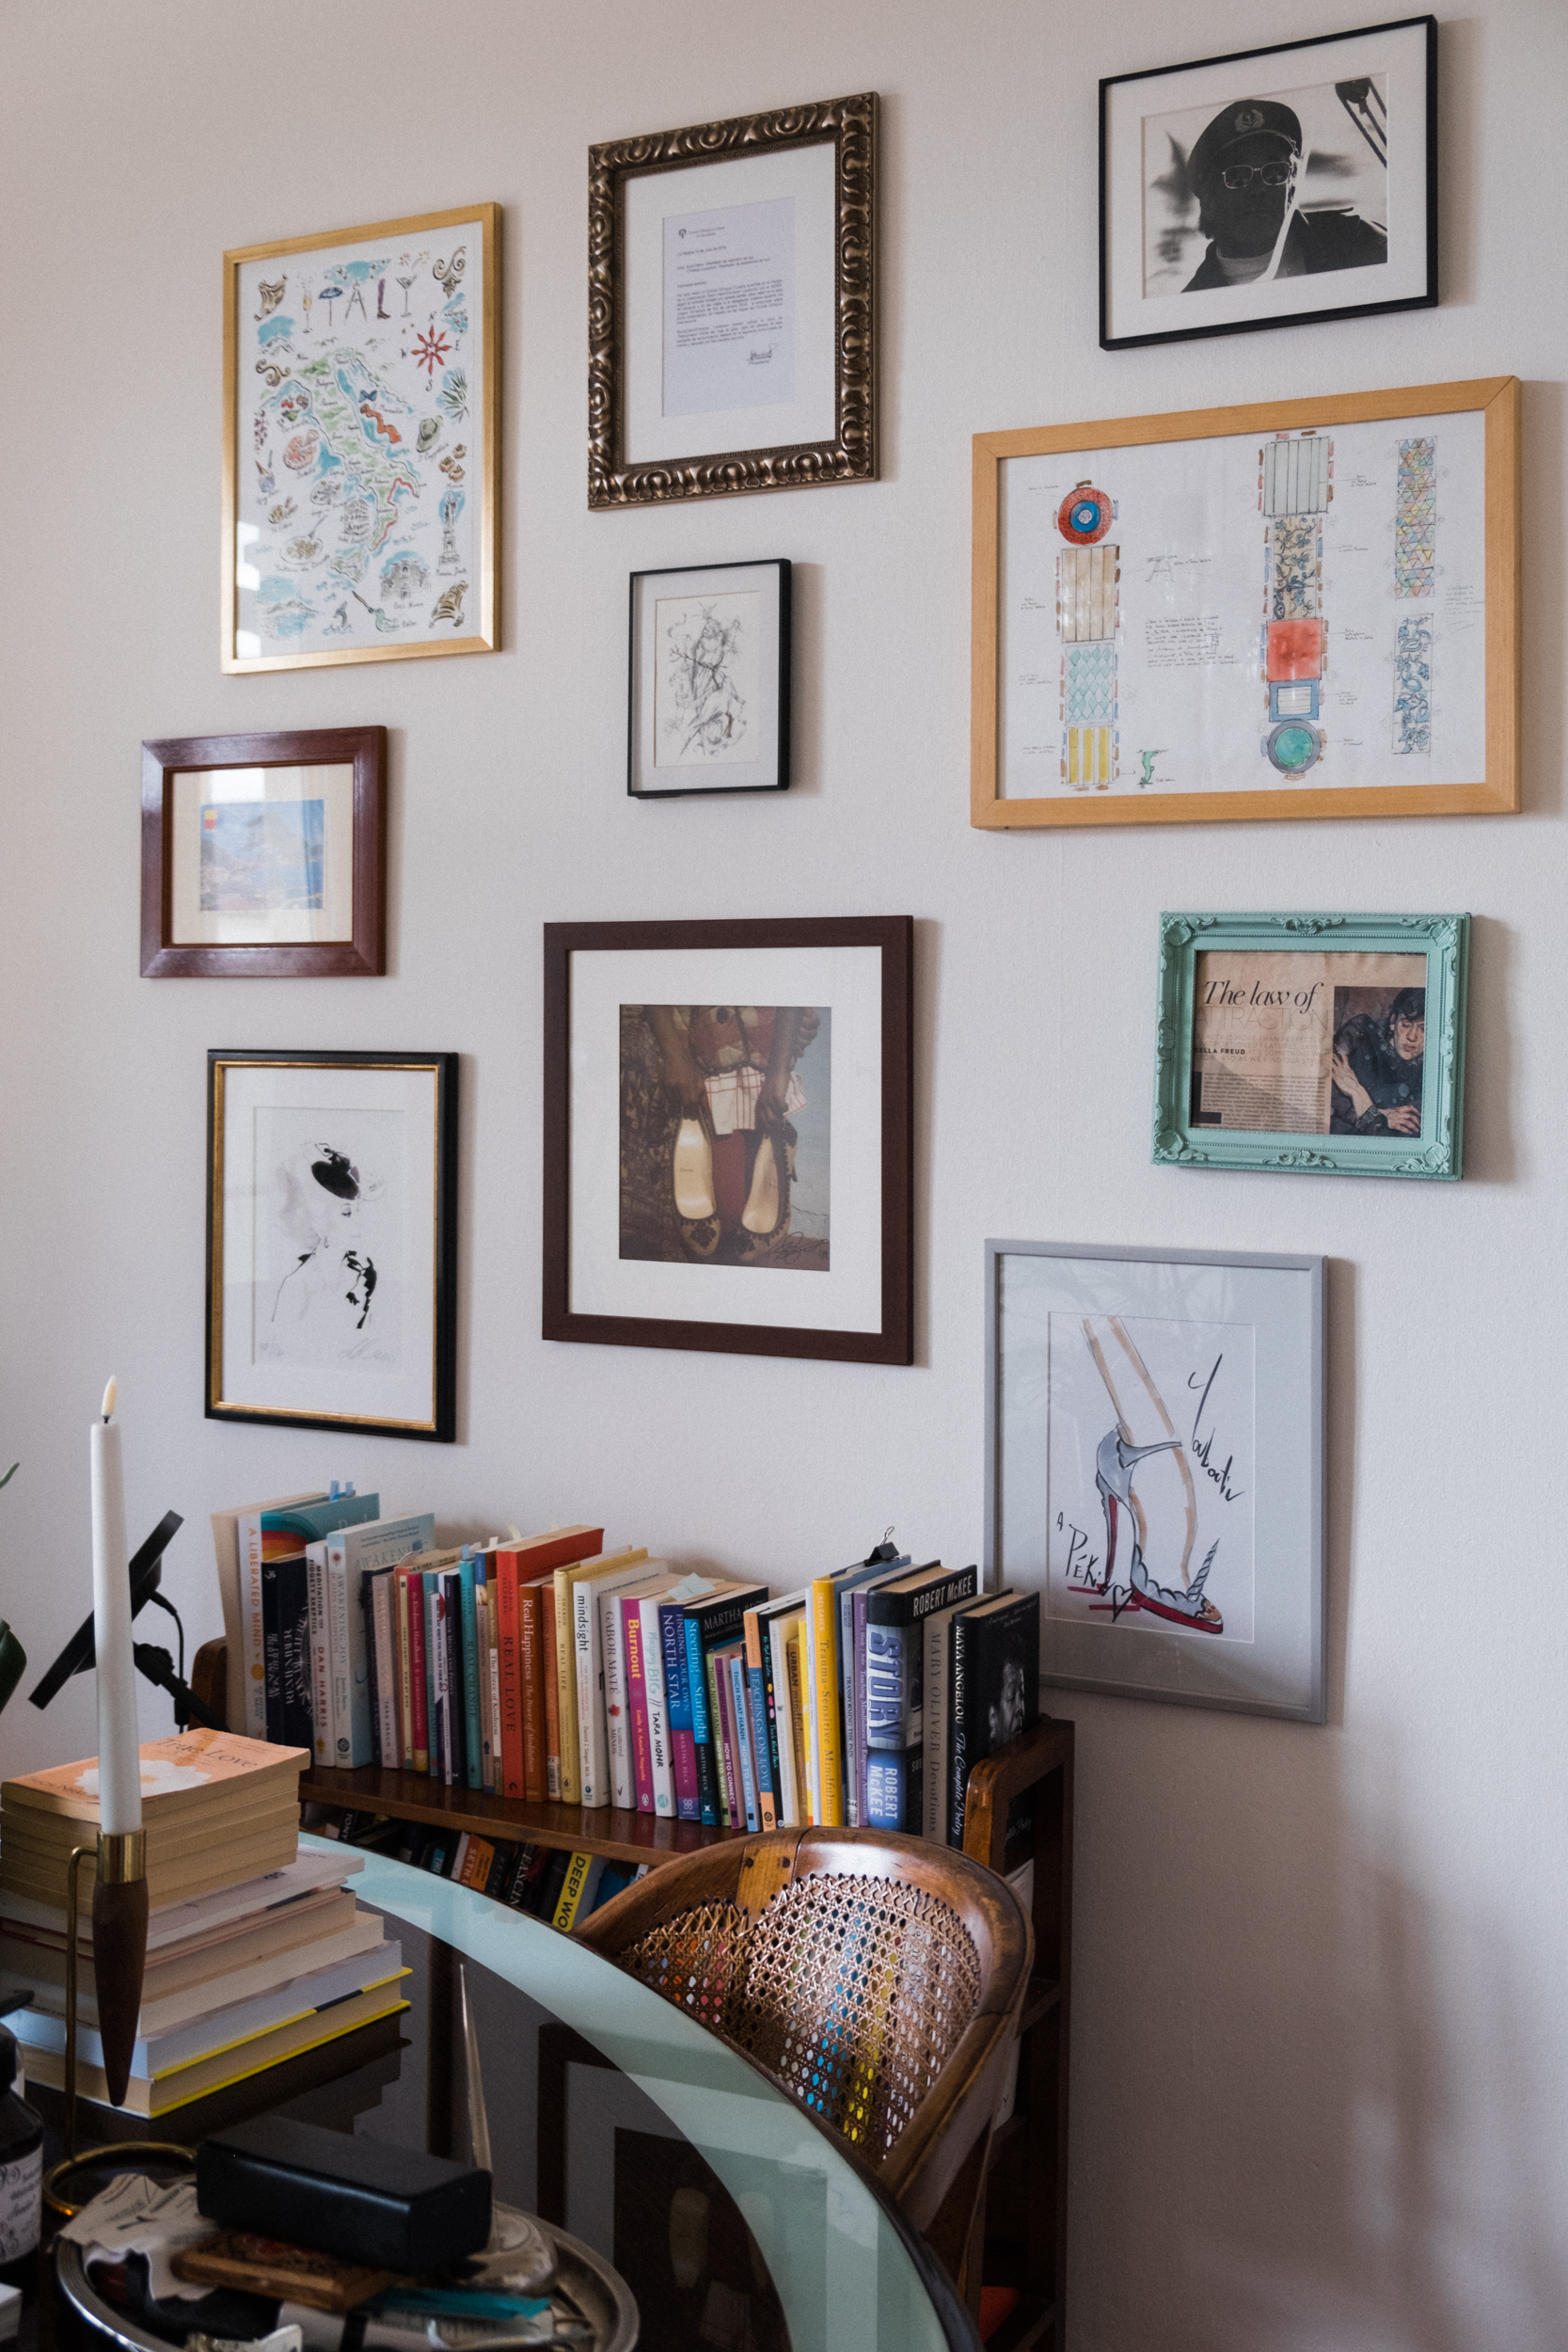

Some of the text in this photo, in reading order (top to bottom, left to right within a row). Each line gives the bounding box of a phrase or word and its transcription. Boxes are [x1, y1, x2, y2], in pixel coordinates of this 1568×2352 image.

[1194, 1006, 1328, 1031] ATTRACTION
[1203, 980, 1324, 1014] The law of
[248, 1527, 261, 1646] A LIBERATED MIND
[315, 1565, 324, 1616] MEDITATION
[337, 1573, 347, 1640] AWAKENING
[913, 1575, 973, 1617] ROBERT McKEE
[412, 1600, 422, 1663] Kindness Handbook
[479, 1610, 487, 1667] LOVINGKINDNESS
[576, 1595, 589, 1651] mindsight
[704, 1607, 742, 1631] MARTHA
[605, 1611, 621, 1694] GABOR MATÉ
[627, 1618, 641, 1678] Burnout
[663, 1613, 681, 1708] NORTH STAR
[675, 1613, 690, 1711] FINDING YOUR OWN
[689, 1621, 702, 1674] Steering
[467, 1641, 477, 1719] REAL CHANGE
[492, 1692, 499, 1700] of
[503, 1636, 516, 1732] REAL LOVE
[521, 1599, 536, 1772] Real Happiness The Power of Meditation
[648, 1668, 660, 1693] BIG
[716, 1668, 724, 1691] THICH
[789, 1651, 802, 1753] URBAN mindfulness
[819, 1640, 831, 1743] Trauma-Sensitive
[859, 1670, 867, 1698] Teaching
[867, 1631, 904, 1741] STORY
[318, 1680, 327, 1728] HARRIS
[492, 1702, 500, 1735] Kindness
[652, 1711, 661, 1734] TARA
[694, 1686, 708, 1740] Starlight
[711, 1712, 720, 1736] HANH
[721, 1715, 729, 1738] HANH
[637, 1734, 645, 1756] Amelia
[714, 1740, 722, 1760] HOW
[733, 1670, 753, 1807] THICH NHAT HANH HOW TO RELAX
[751, 1671, 769, 1788] TEACHINGS ON LOVE
[929, 1633, 942, 1832] MARY OLIVER Devotions
[951, 1626, 967, 1836] MAYA ANGELOU The Complete Poetry
[157, 1738, 258, 1768] True Love
[639, 1756, 647, 1781] Nagoski
[654, 1739, 664, 1768] MOHR
[679, 1733, 689, 1785] MARTHA BECK
[717, 1762, 723, 1773] TO
[725, 1759, 732, 1771] TO
[860, 1749, 868, 1780] Empower
[719, 1774, 727, 1799] WALK
[726, 1772, 736, 1805] CONNECT
[824, 1749, 834, 1823] Mindfulness
[861, 1781, 869, 1819] Adolescents
[869, 1765, 898, 1819] ROBERT McKEE
[341, 1813, 353, 1840] TONY
[464, 1847, 478, 1879] SETH
[565, 1855, 587, 1898] DEEP
